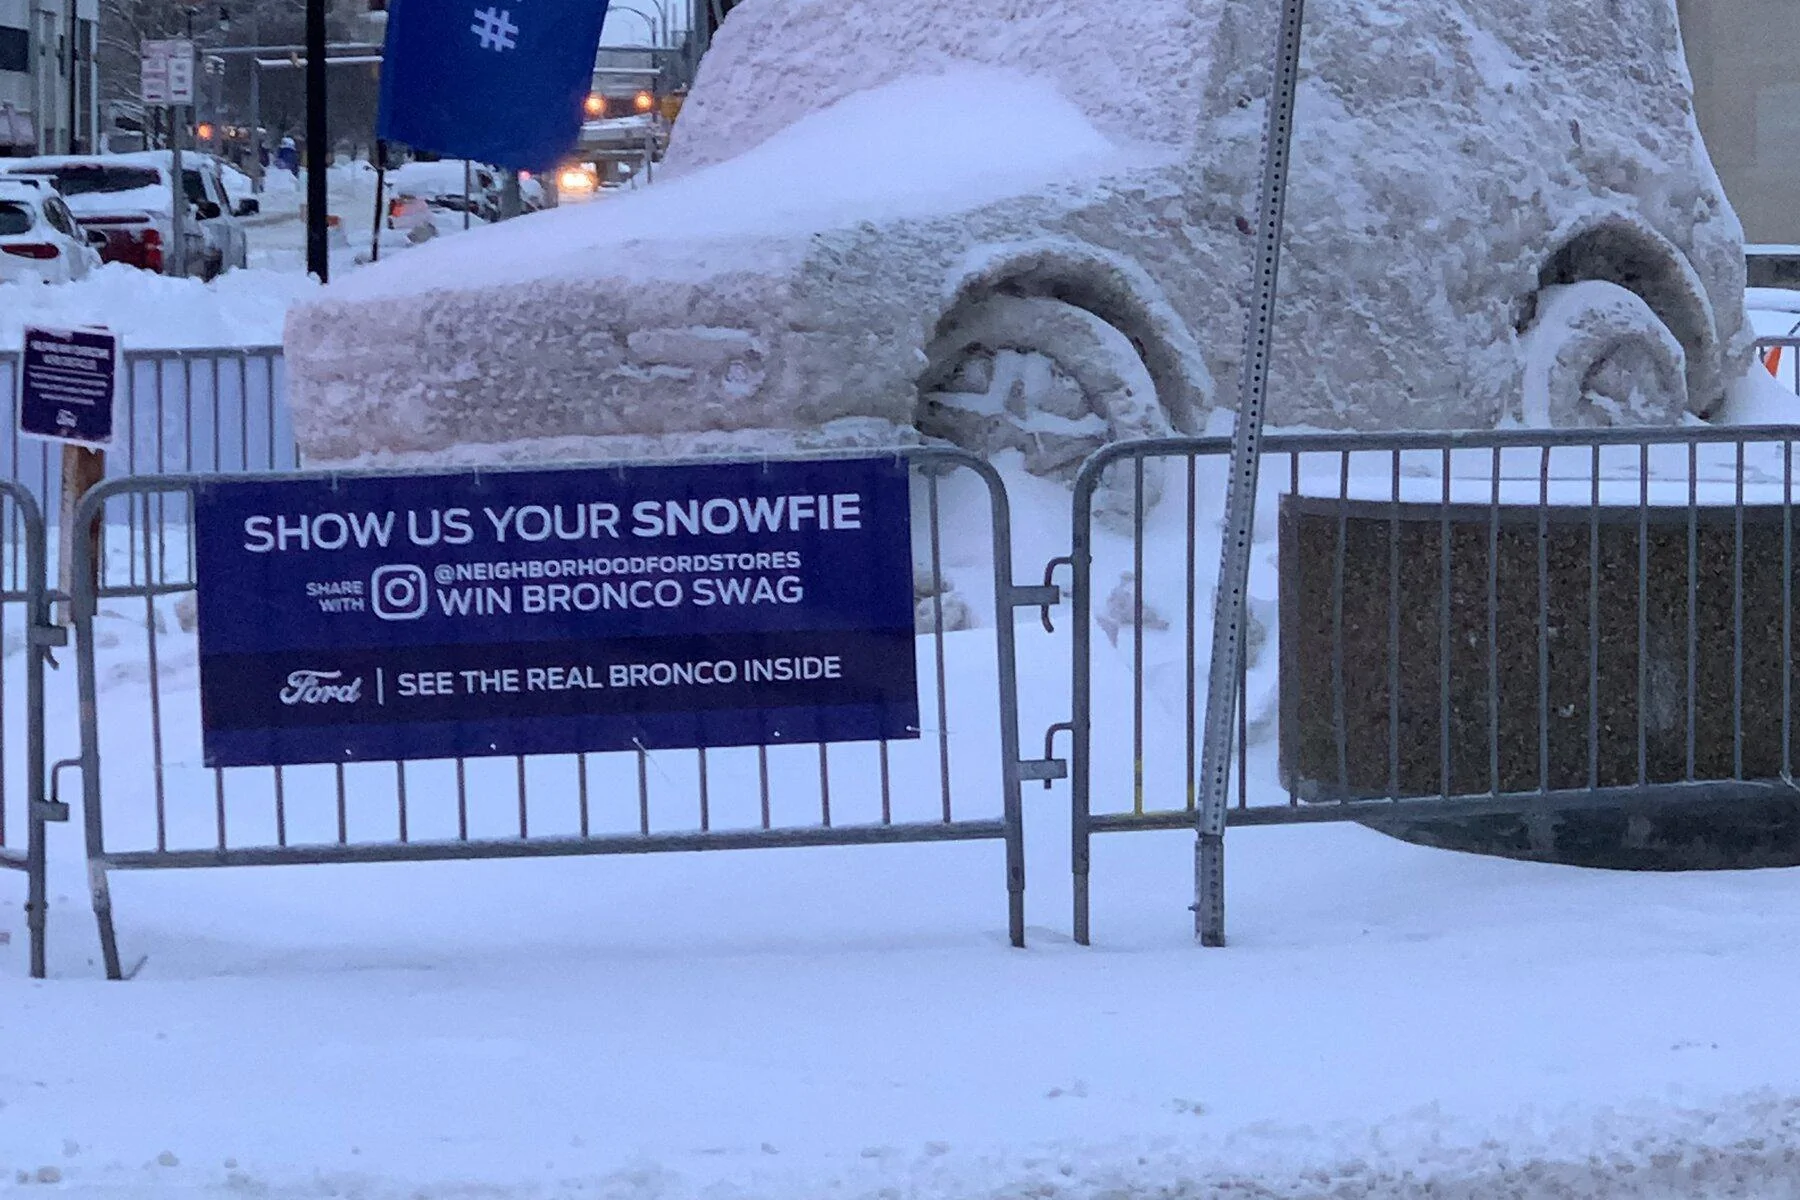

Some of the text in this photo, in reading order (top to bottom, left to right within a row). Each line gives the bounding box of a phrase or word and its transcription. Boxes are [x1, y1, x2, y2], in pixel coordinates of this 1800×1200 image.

[244, 493, 862, 552] SHOW US YOUR SNOWFIE
[433, 550, 802, 585] @NEIGHBORHOODFORDSTORES
[305, 580, 365, 597] SHARE
[318, 597, 365, 614] WITH
[436, 574, 804, 617] WIN BRONCO SWAG
[279, 668, 363, 705] Ford
[397, 655, 843, 697] SEE THE REAL BRONCO INSIDE
